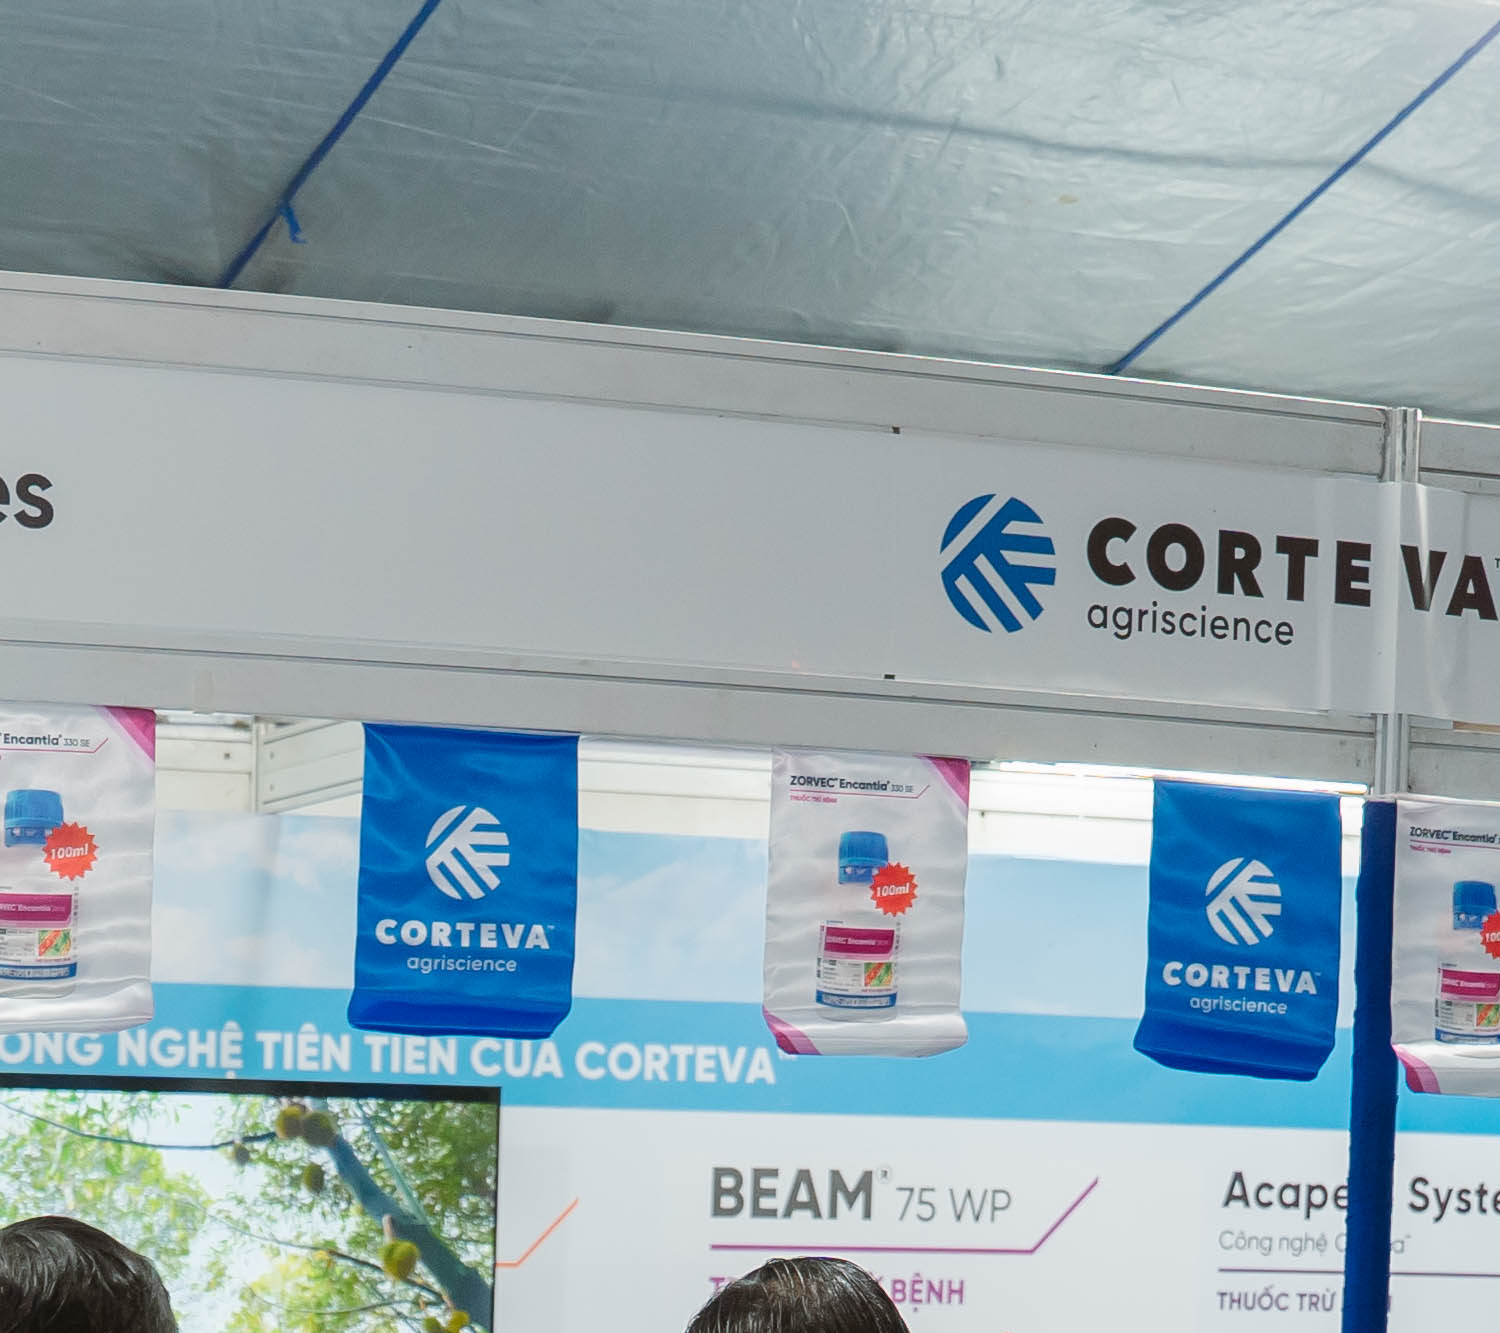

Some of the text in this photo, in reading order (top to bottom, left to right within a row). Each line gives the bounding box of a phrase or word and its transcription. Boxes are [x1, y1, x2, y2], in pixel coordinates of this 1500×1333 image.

[1087, 601, 1294, 646] agriscience
[64, 738, 78, 746] 330
[81, 739, 89, 747] SE
[51, 844, 88, 860] 100ml
[877, 883, 910, 897] 100ml
[406, 952, 518, 975] agriscience
[1189, 993, 1288, 1017] agriscience
[117, 1021, 242, 1080] NGHỆ
[256, 1025, 351, 1072] TIÊN
[896, 1186, 938, 1223] 75
[949, 1187, 1012, 1223] WP
[1223, 1171, 1349, 1220] Acape
[1218, 1230, 1273, 1256] Công
[1278, 1233, 1327, 1257] nghệ
[891, 1273, 965, 1313] BỆNH
[1217, 1285, 1336, 1312] THUỐC TRỪ
